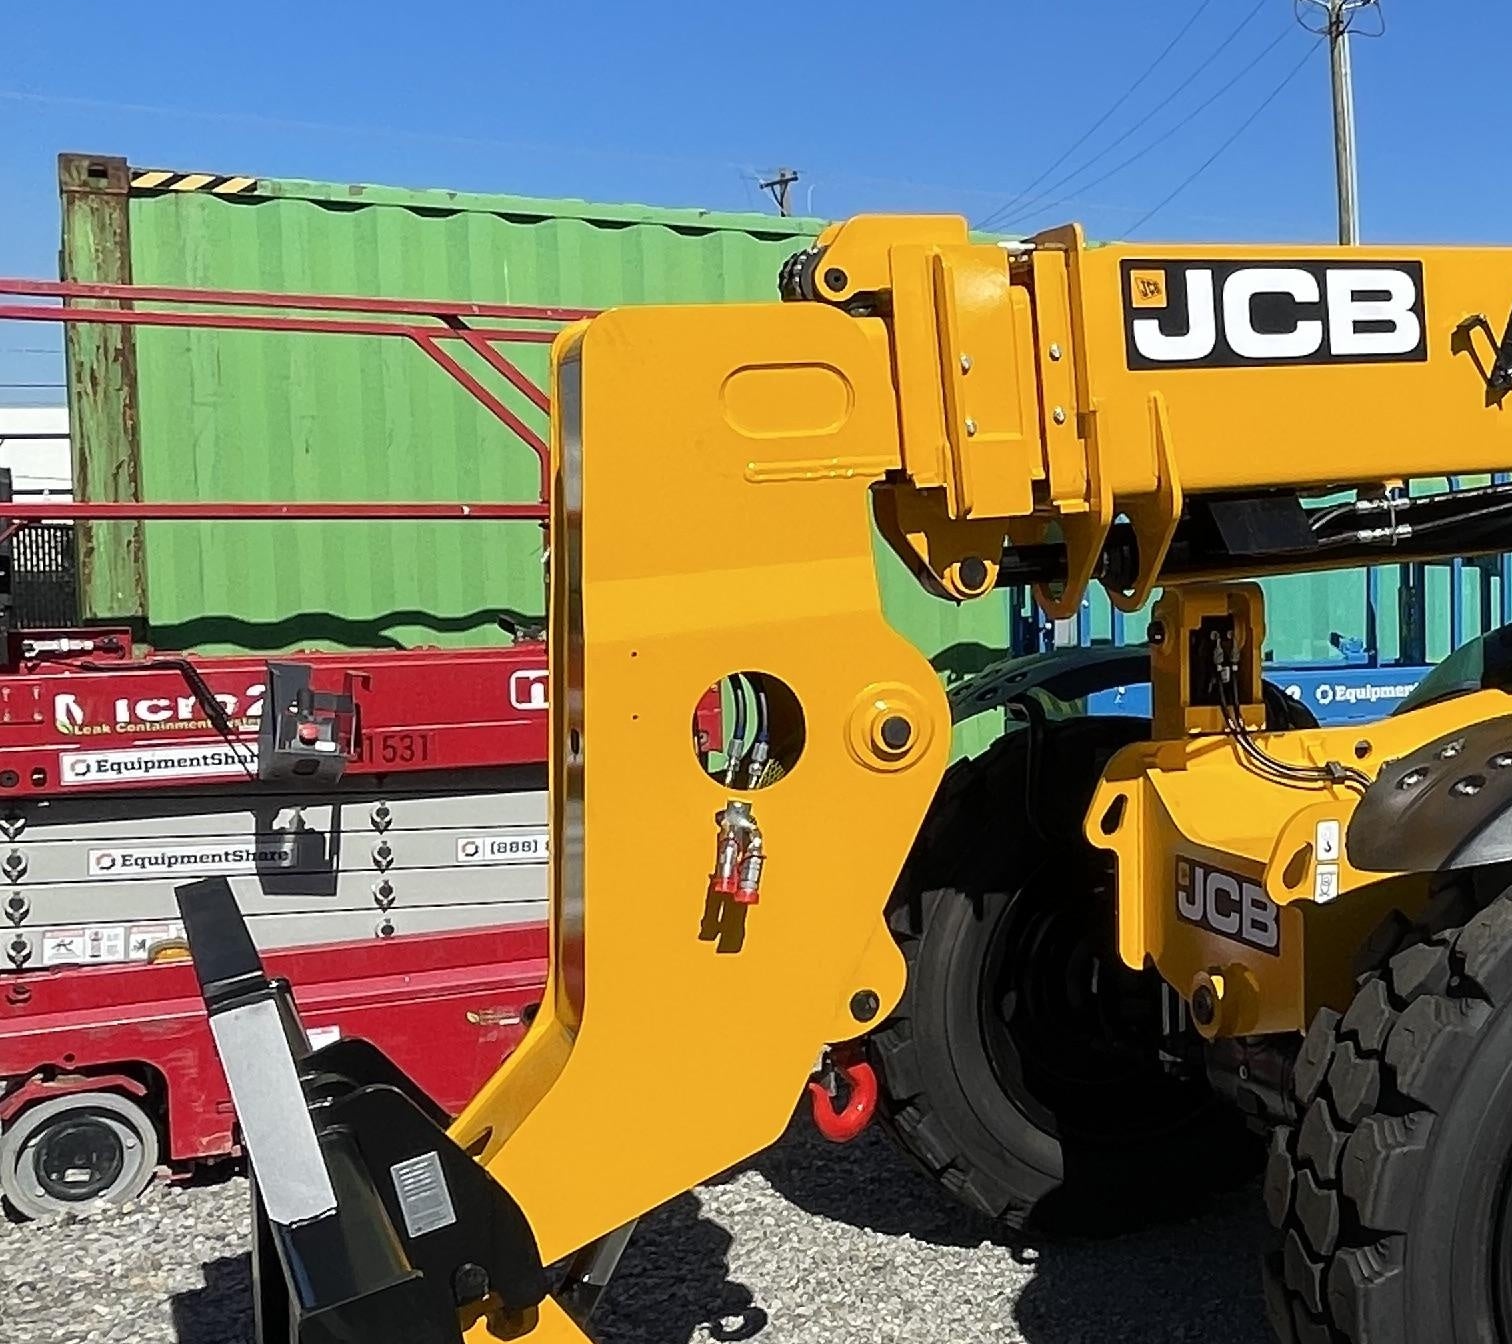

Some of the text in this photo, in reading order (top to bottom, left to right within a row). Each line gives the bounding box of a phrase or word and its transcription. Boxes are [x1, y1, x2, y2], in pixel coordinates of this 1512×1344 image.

[1133, 268, 1420, 361] JCB
[73, 723, 111, 736] Leak
[115, 718, 213, 734] Containment
[96, 751, 258, 774] EquipmentShar
[121, 848, 290, 869] EquipmentShare
[1178, 866, 1278, 948] JCB
